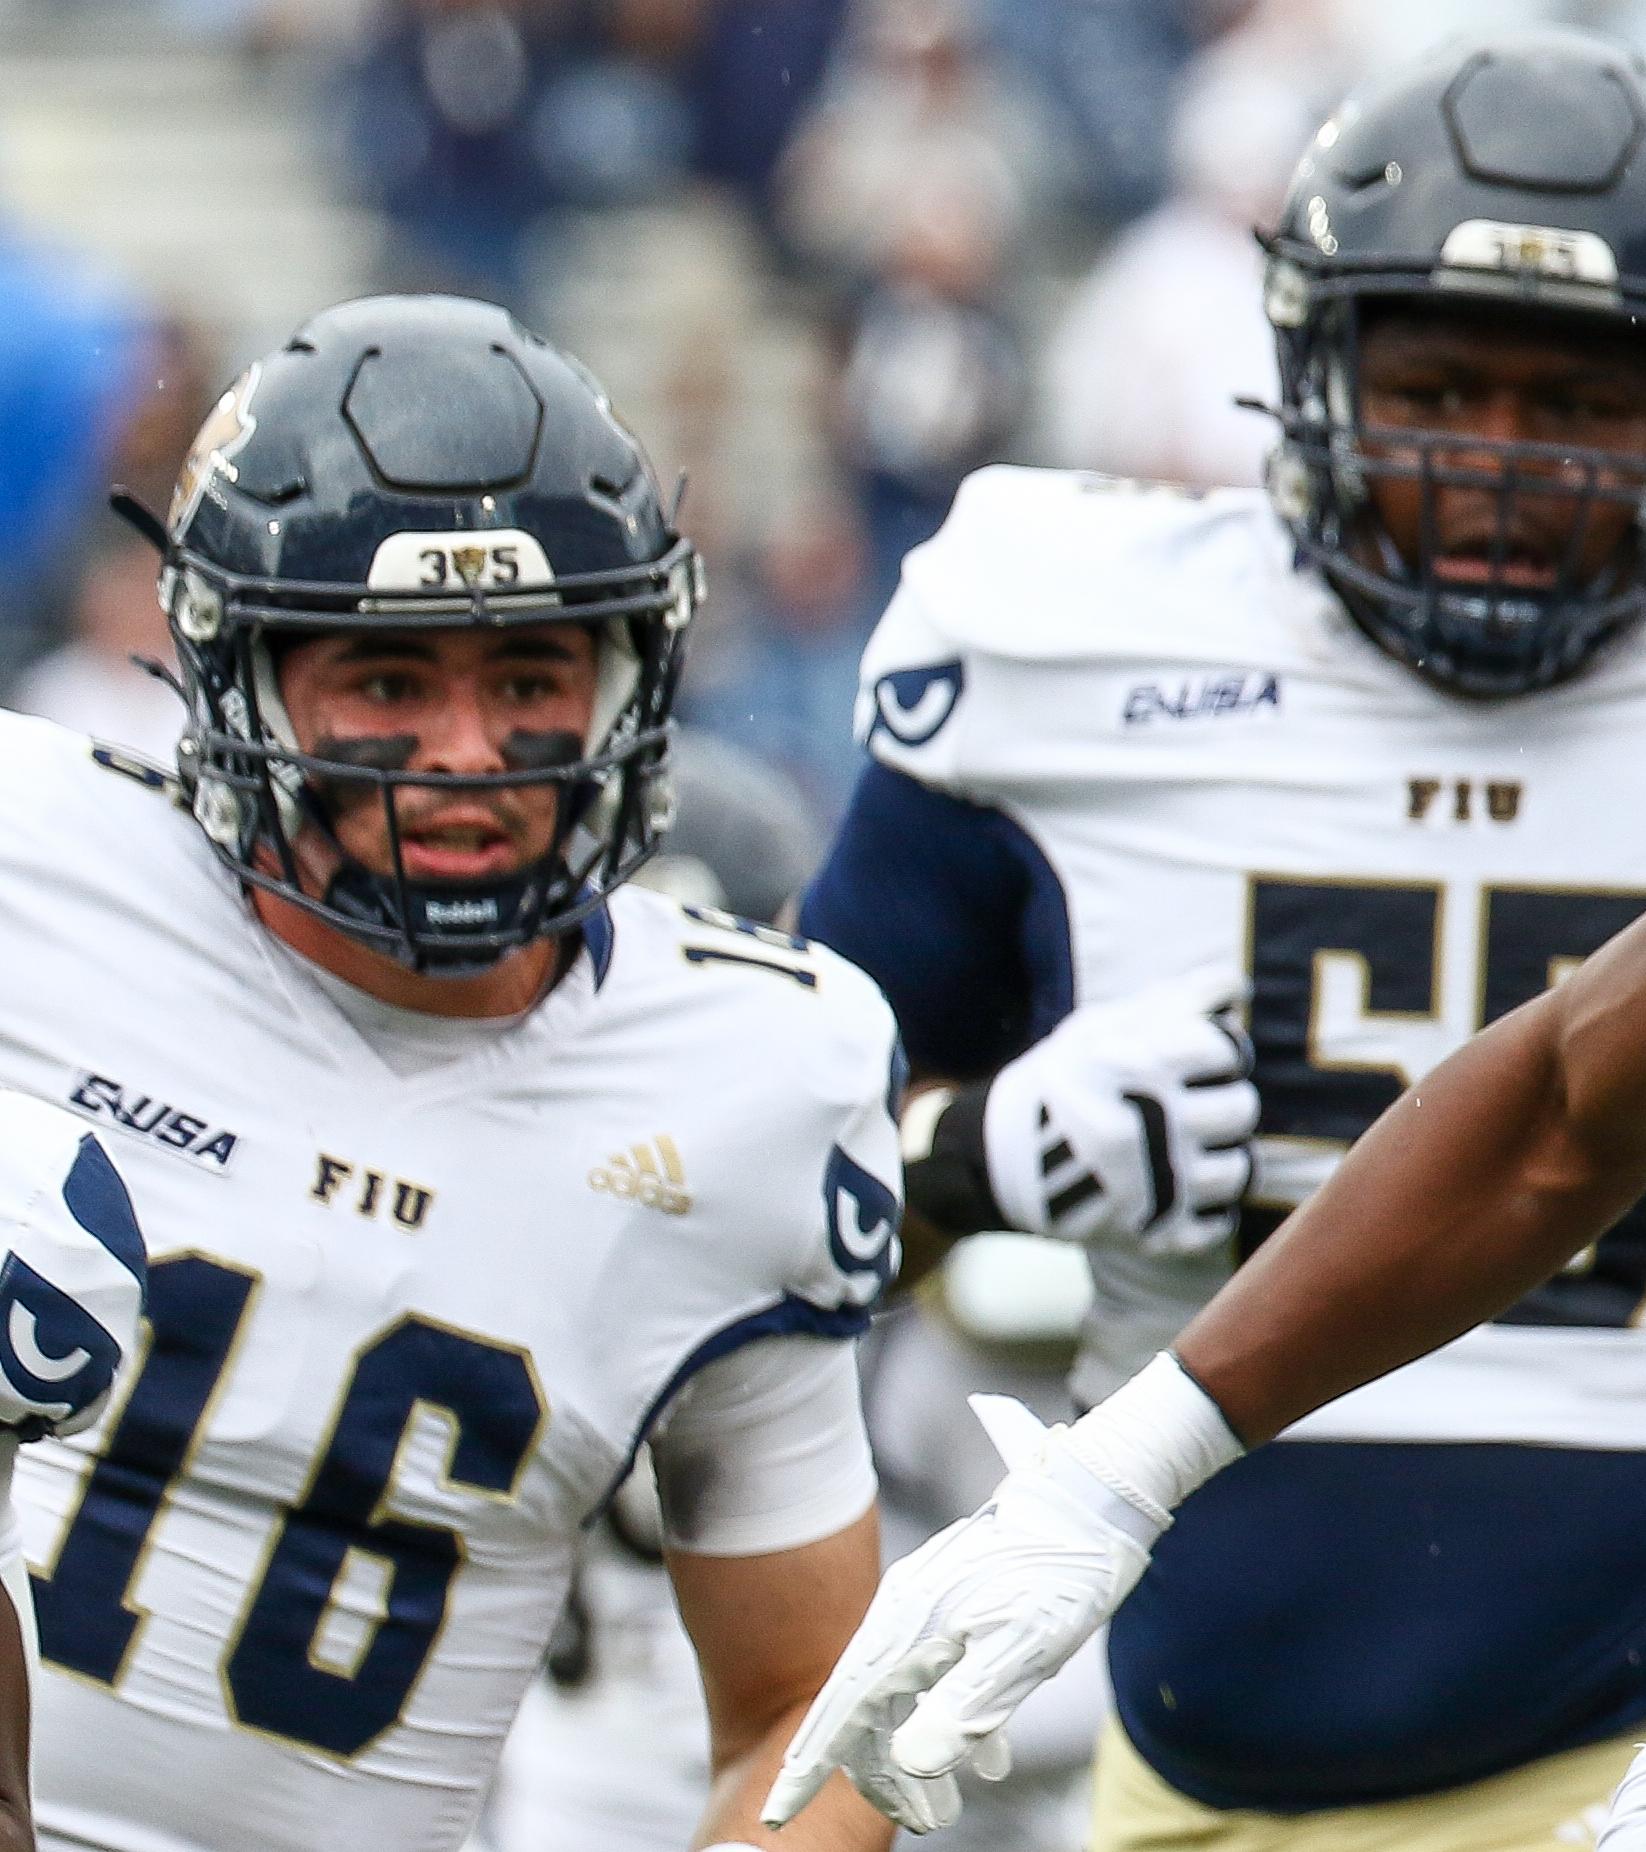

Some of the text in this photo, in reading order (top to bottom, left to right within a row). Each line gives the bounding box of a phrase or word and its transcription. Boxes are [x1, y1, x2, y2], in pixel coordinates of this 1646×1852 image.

[1405, 778, 1522, 821] FIU
[310, 1153, 435, 1230] FIU
[25, 1248, 550, 1766] 16
